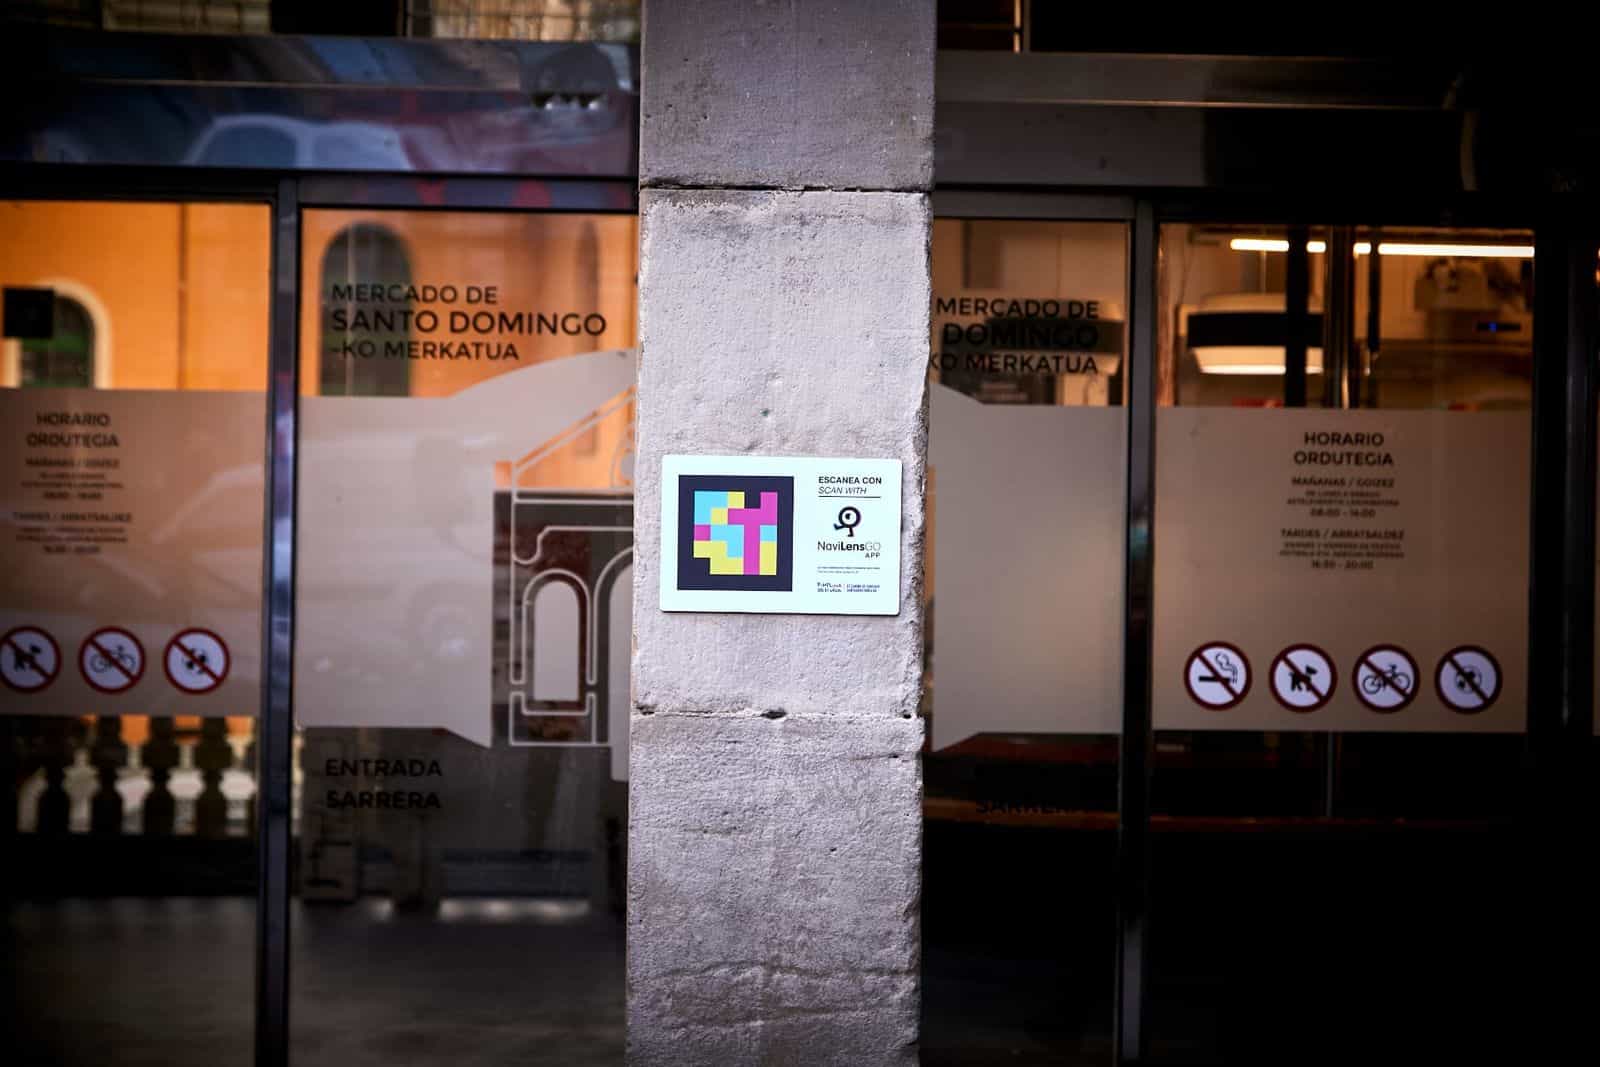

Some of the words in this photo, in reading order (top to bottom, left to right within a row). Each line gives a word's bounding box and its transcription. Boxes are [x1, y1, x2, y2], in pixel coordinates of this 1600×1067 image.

[331, 284, 458, 305] MERCADO
[465, 286, 498, 305] DE
[936, 298, 1060, 319] MERCADO
[1068, 301, 1100, 319] DE
[331, 310, 439, 333] SANTO
[449, 311, 607, 336] DOMINGO
[943, 323, 1099, 346] DOMINGO
[384, 341, 520, 361] MERKATUA
[966, 354, 1098, 373] MERKATUA
[36, 413, 110, 426] HORARIO
[1303, 431, 1385, 447] HORARIO
[1293, 451, 1394, 467] ORDUTEGIA
[818, 475, 860, 484] ESCANEA
[862, 476, 882, 485] CON
[818, 485, 843, 495] SCAN
[845, 487, 867, 495] WITH
[817, 540, 882, 552] NaviLensGO
[326, 759, 442, 776] ENTRADA
[327, 792, 441, 808] SARRERA
